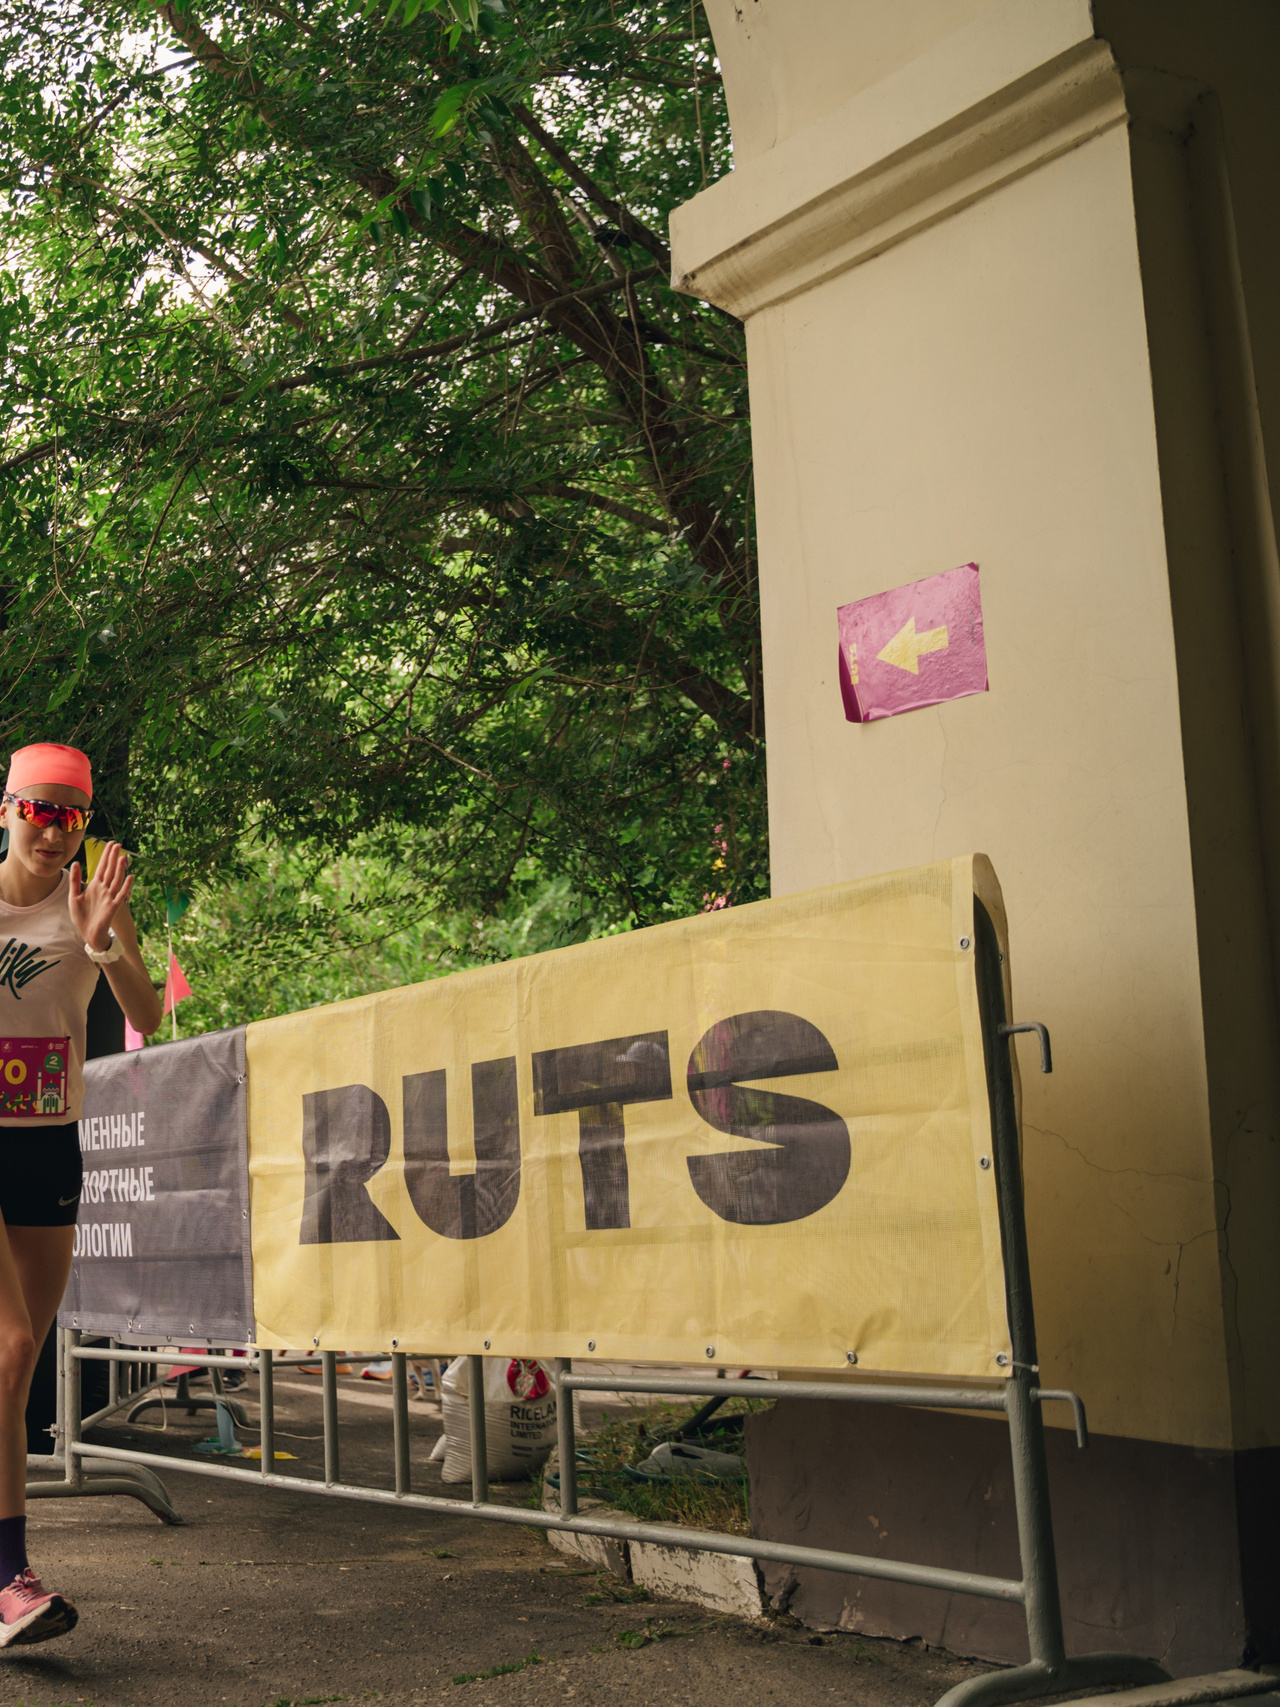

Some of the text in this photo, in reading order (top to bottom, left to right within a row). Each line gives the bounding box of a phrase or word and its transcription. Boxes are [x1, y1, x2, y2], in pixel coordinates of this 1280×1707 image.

[49, 1056, 58, 1065] 2
[78, 1111, 145, 1152] МЕННЫЕ
[299, 1009, 852, 1245] RUTS
[80, 1166, 156, 1204] ПОРТНЫЕ
[72, 1222, 133, 1258] ОЛОГИИ
[510, 1430, 543, 1440] LIMITED
